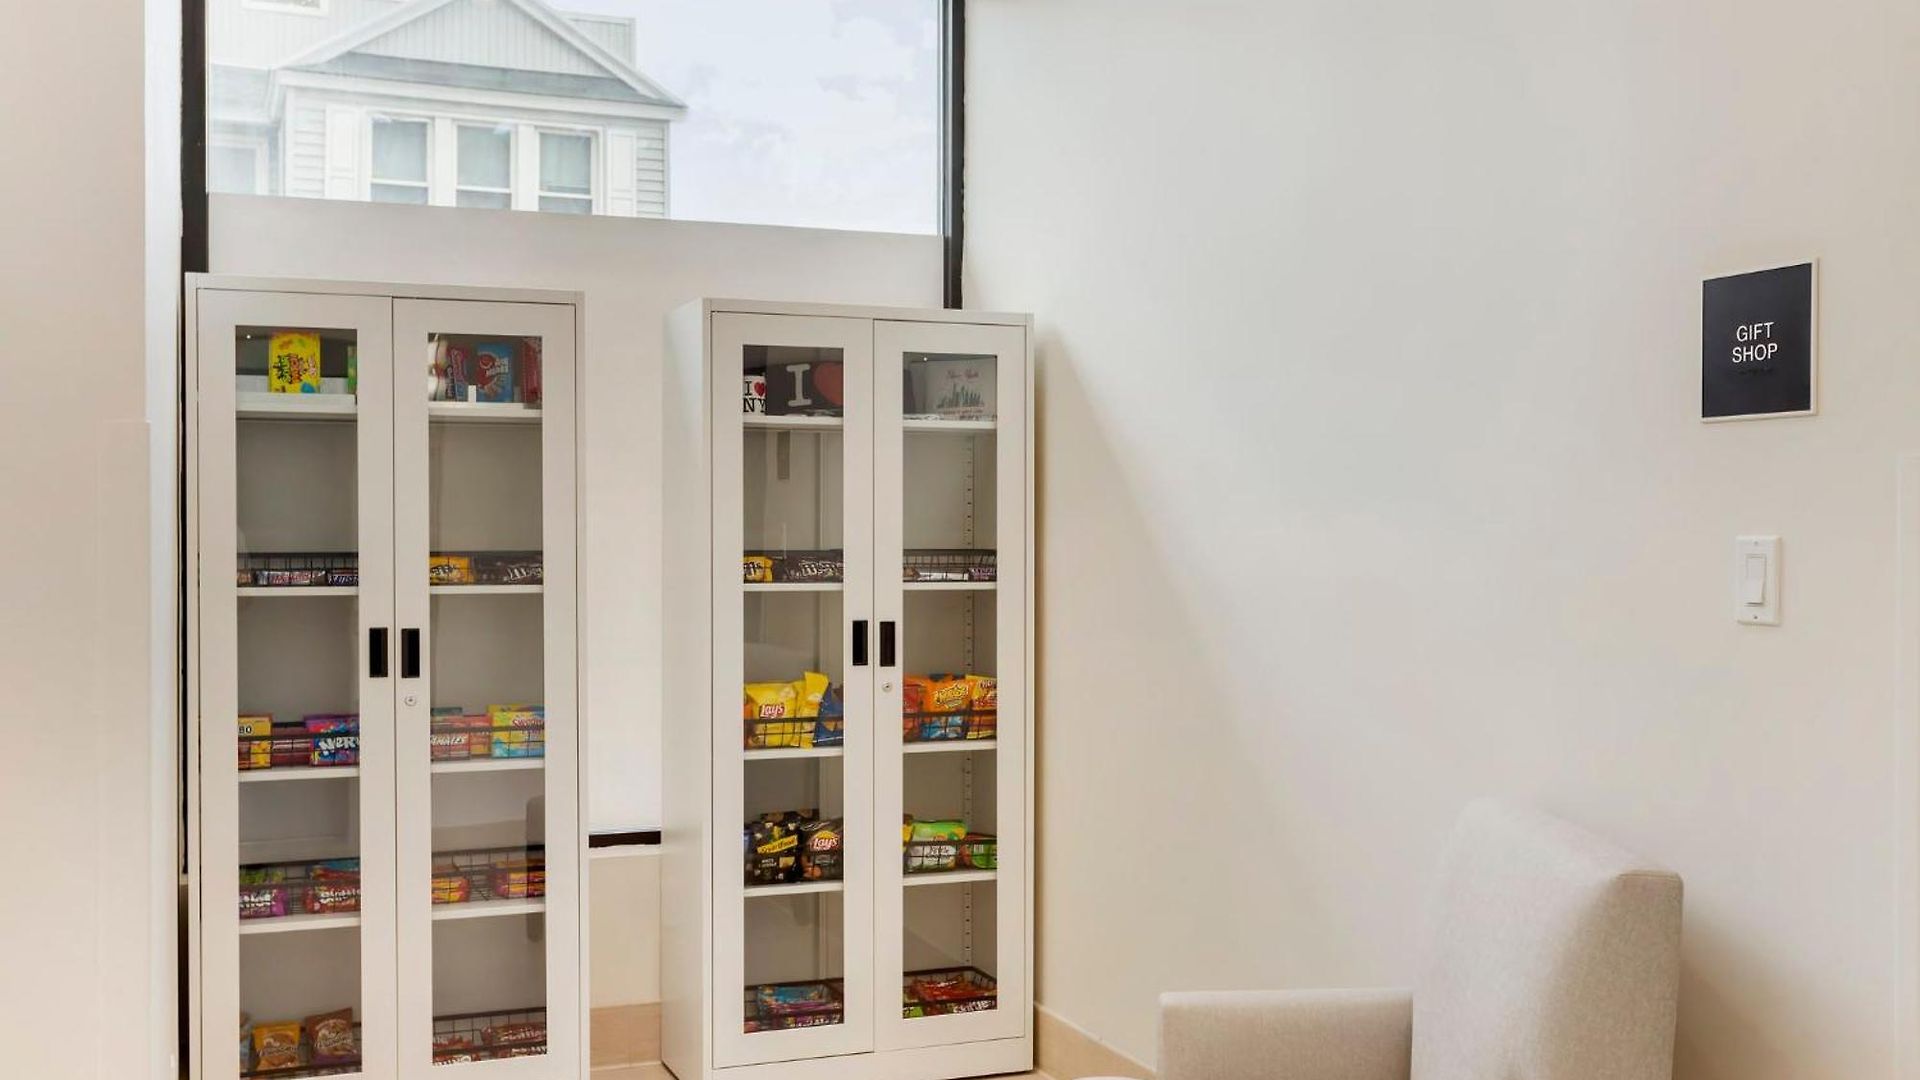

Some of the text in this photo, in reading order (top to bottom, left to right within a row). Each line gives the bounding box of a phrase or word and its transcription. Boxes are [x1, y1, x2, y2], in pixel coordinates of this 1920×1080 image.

[1736, 322, 1774, 342] GIFT
[1732, 343, 1778, 363] SHOP
[744, 381, 752, 396] I
[785, 363, 811, 407] I
[743, 398, 766, 413] NY
[319, 736, 360, 750] NER
[812, 836, 838, 851] Lay's
